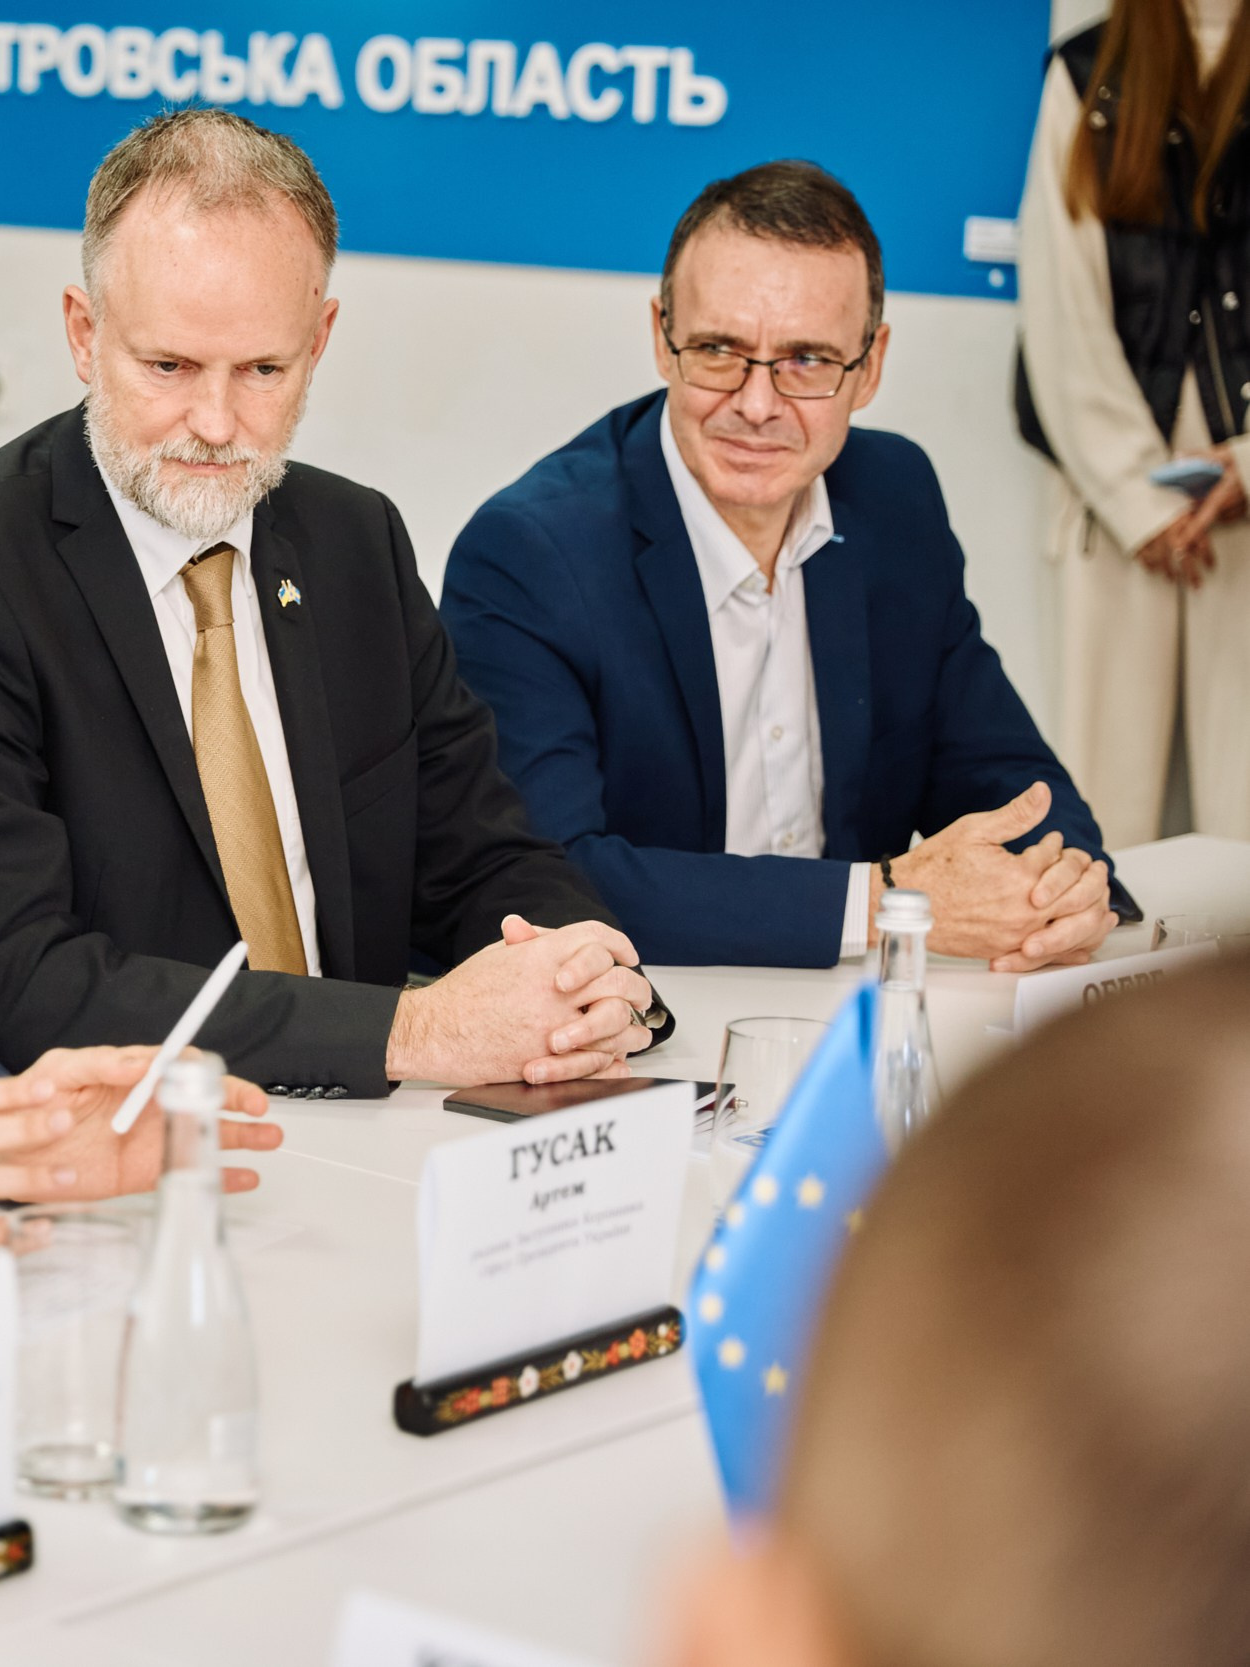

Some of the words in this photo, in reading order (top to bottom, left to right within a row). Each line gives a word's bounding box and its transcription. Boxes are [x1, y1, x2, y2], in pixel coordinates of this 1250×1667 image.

[356, 35, 728, 126] ОБЛАСТЬ
[509, 1120, 616, 1181] ГУСАК
[529, 1180, 586, 1213] Артем
